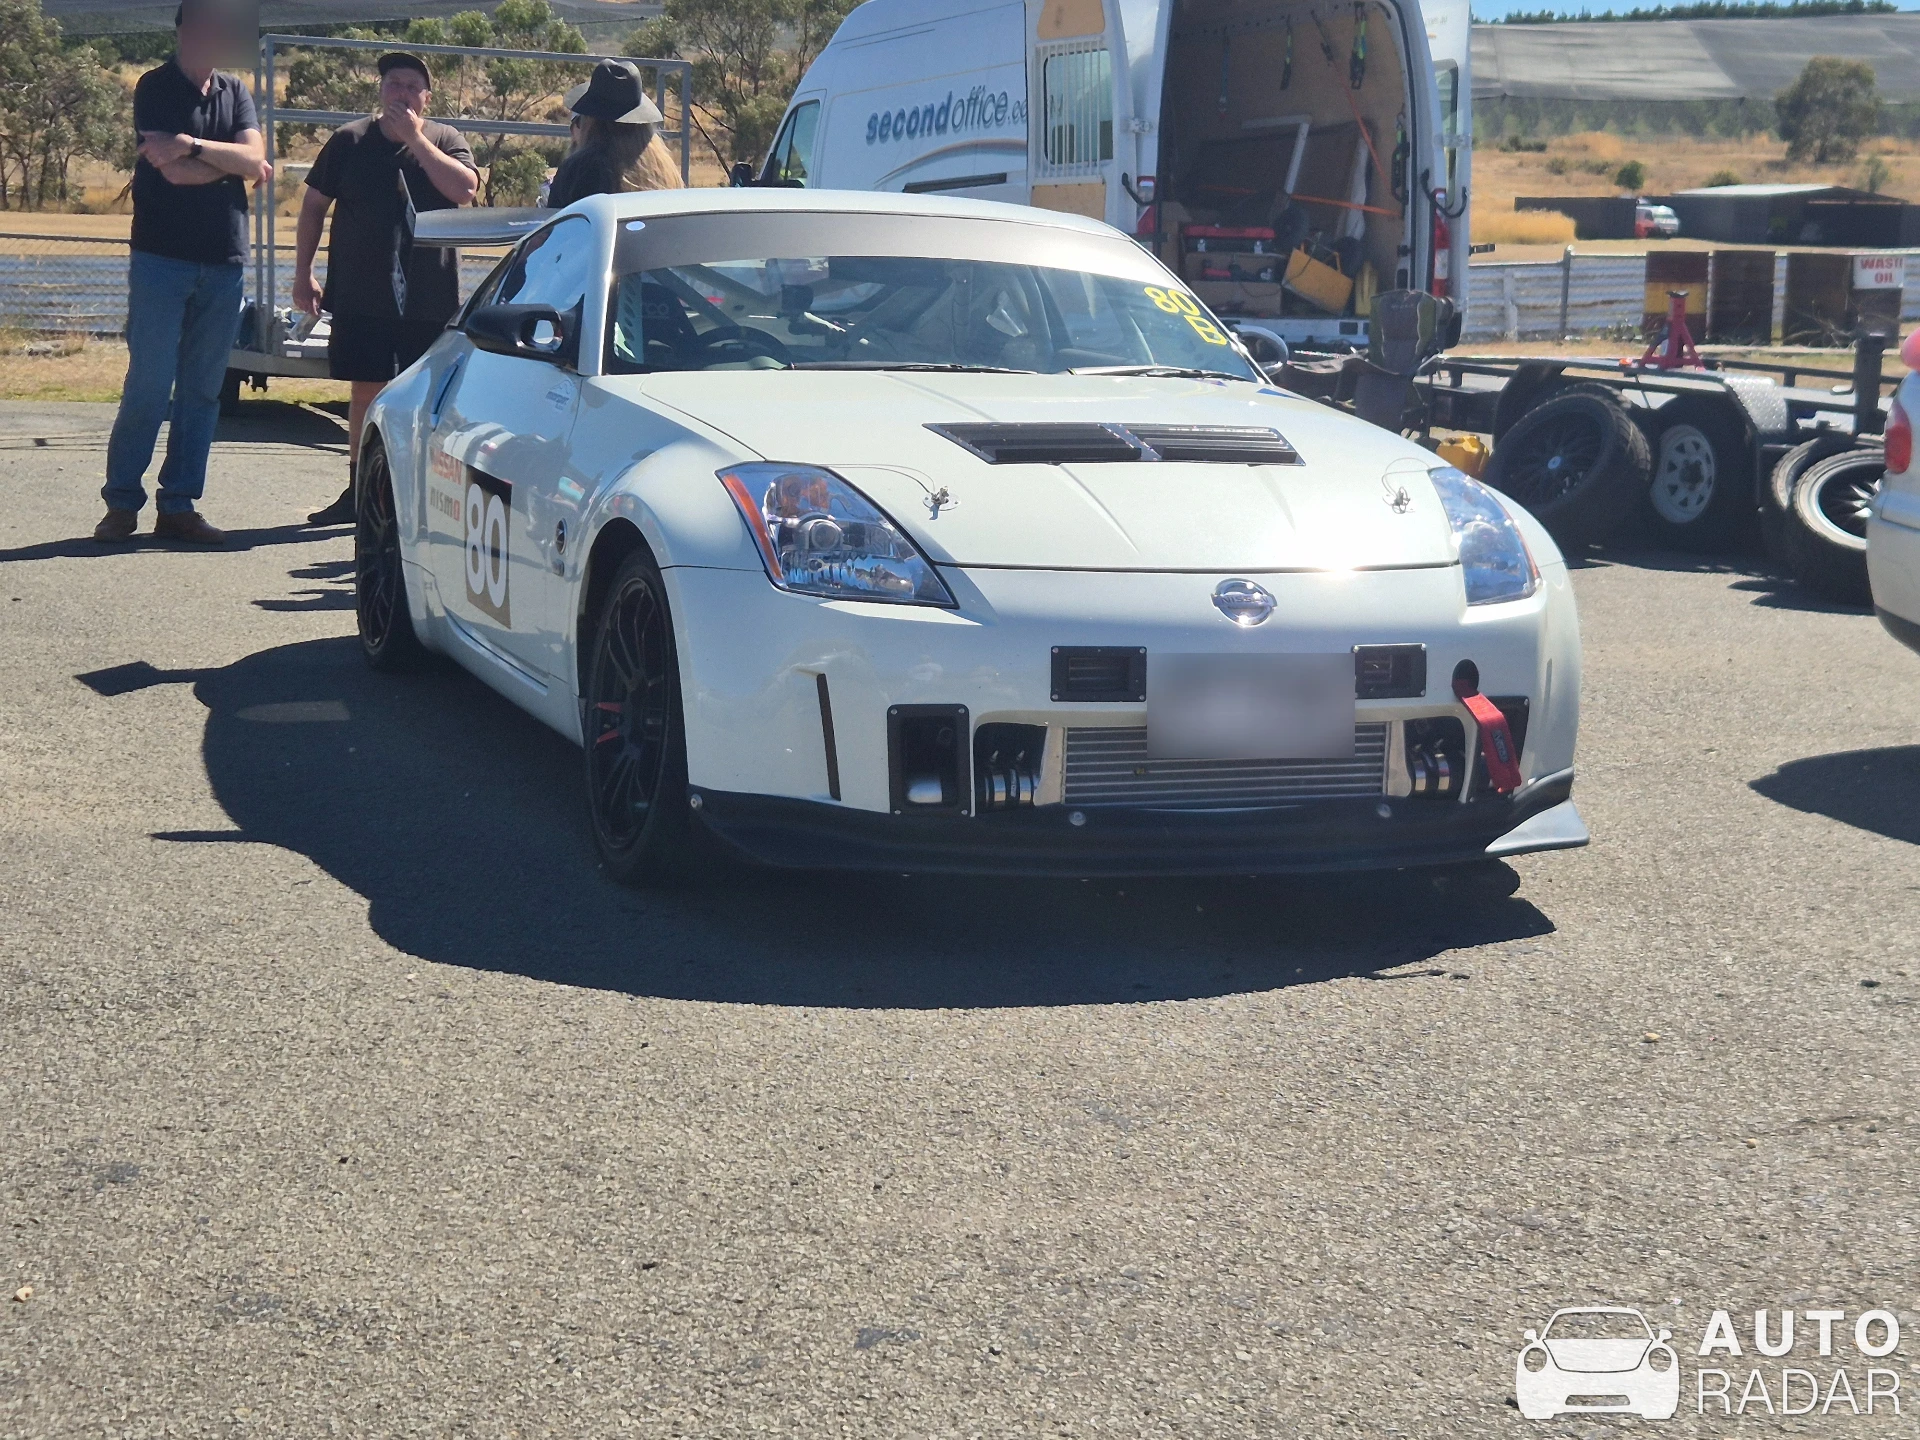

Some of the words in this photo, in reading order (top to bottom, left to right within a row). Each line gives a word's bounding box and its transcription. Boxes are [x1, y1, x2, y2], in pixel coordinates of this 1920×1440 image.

[1143, 286, 1201, 316] 80
[1184, 314, 1228, 346] B
[466, 483, 507, 609] 80
